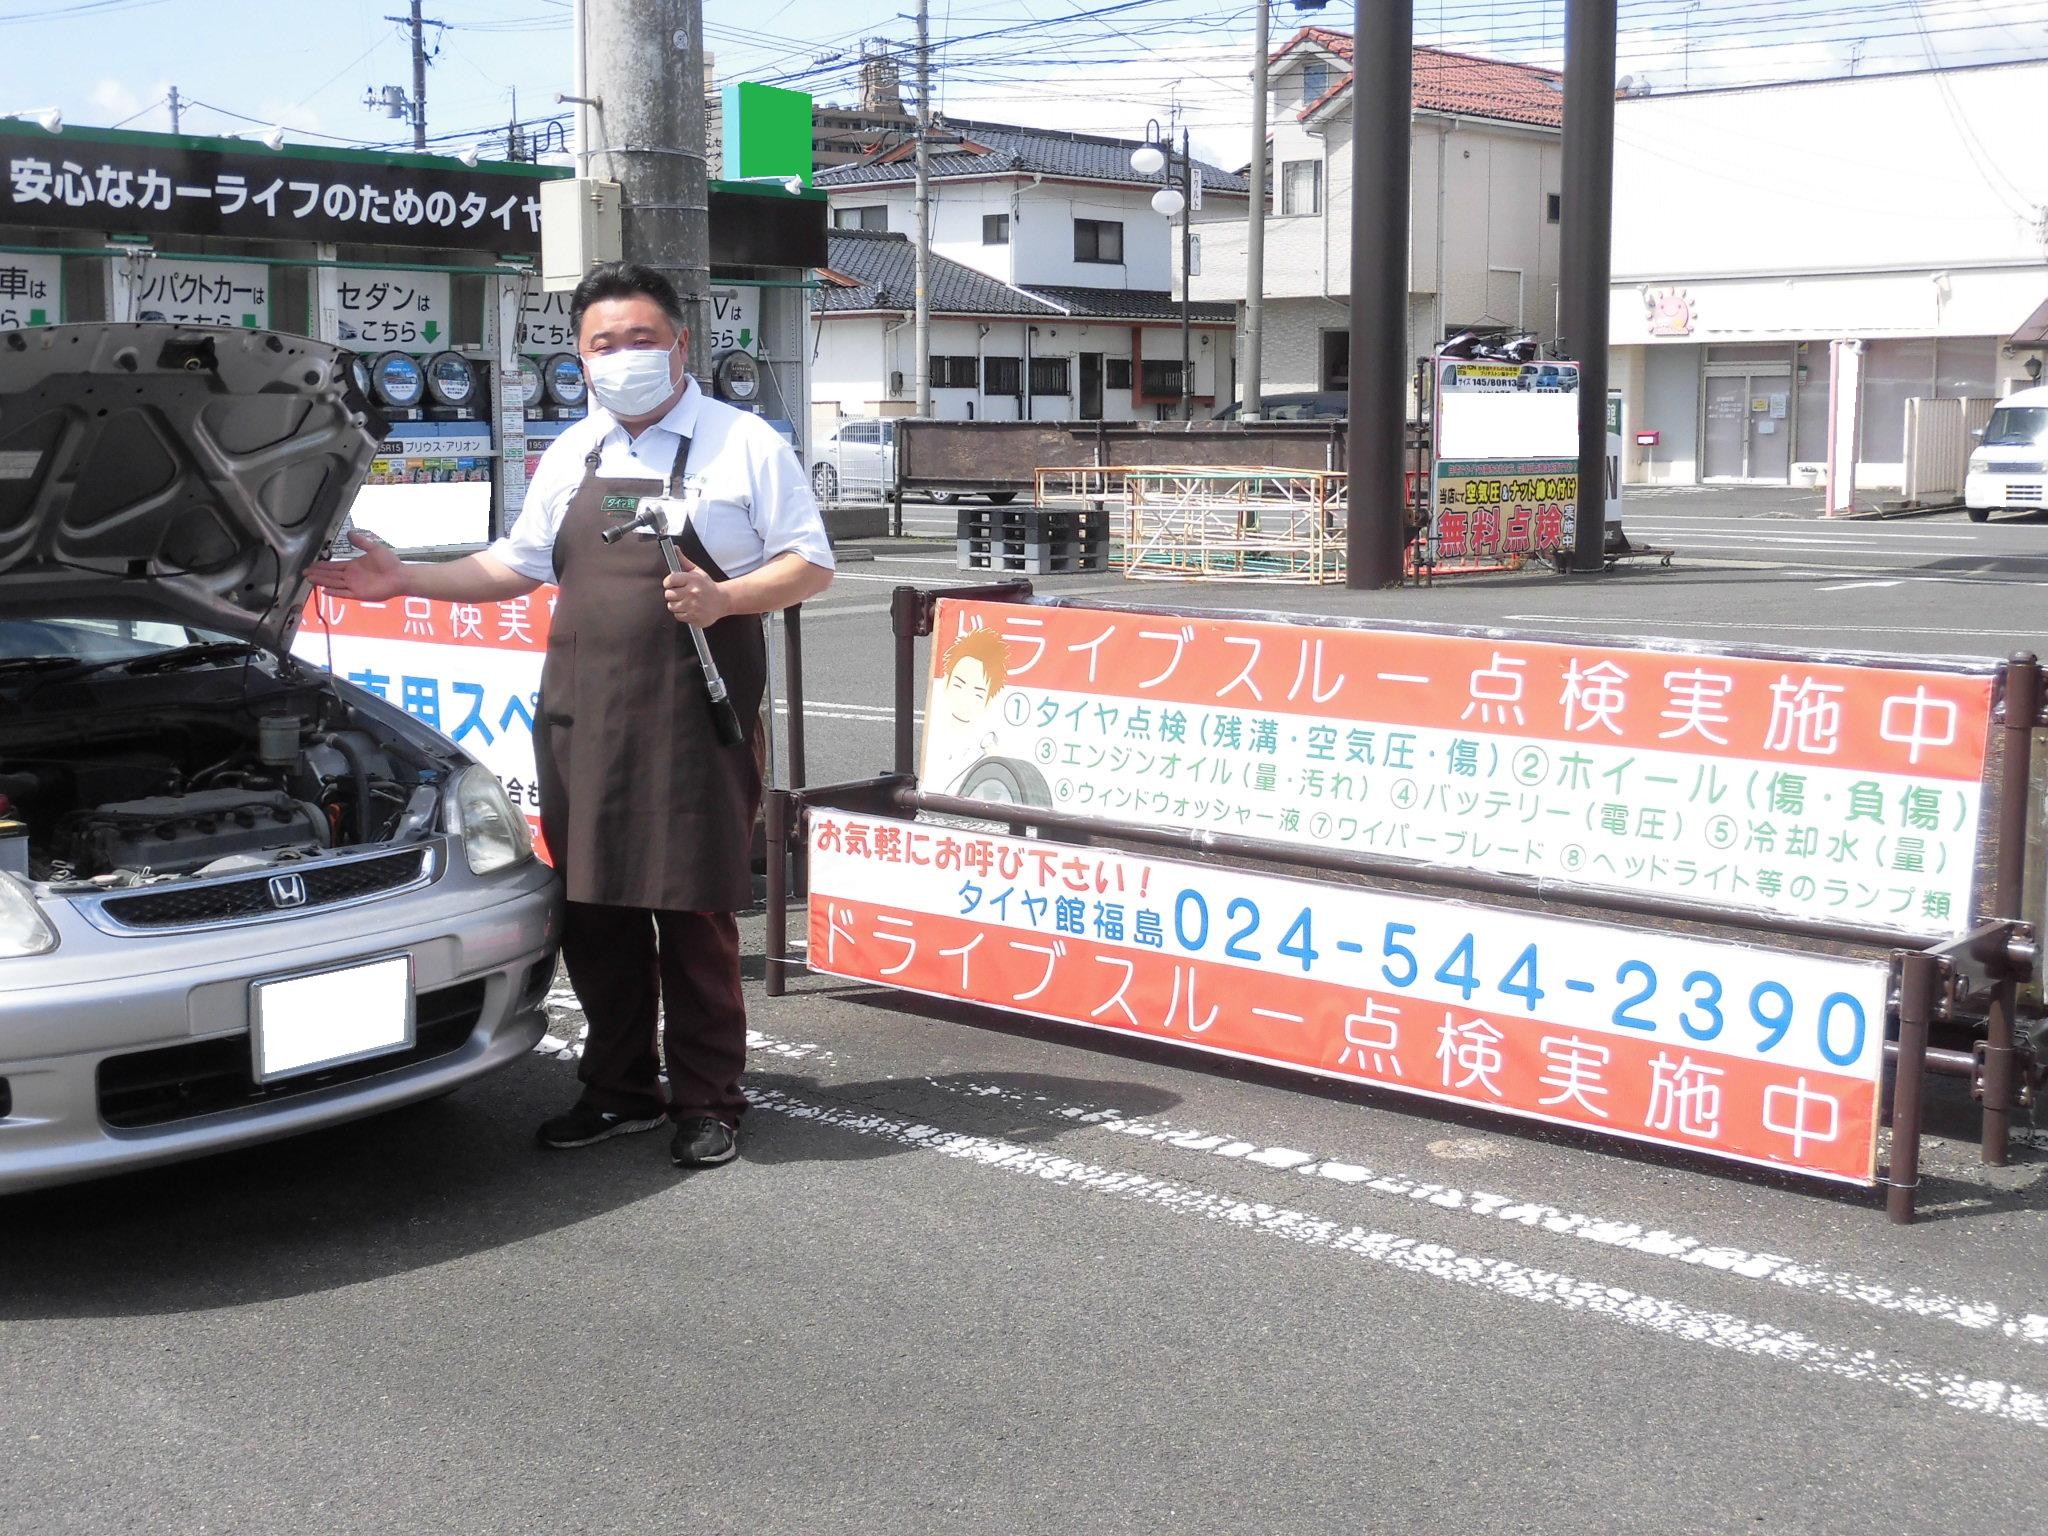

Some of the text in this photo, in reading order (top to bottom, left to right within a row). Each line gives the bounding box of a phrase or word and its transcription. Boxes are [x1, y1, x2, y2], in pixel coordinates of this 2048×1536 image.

[337, 282, 431, 311] セダンは
[361, 321, 416, 343] こちら
[1472, 378, 1517, 388] 145/80R13
[379, 443, 401, 453] 5R15
[405, 441, 480, 453] プリウス・アリオン
[1437, 503, 1562, 557] 無料点検
[496, 776, 541, 807] 合も
[958, 879, 1866, 1067] タイヤ館福島 024-544-2390
[826, 903, 1840, 1158] ドライブスルー点検実施中
